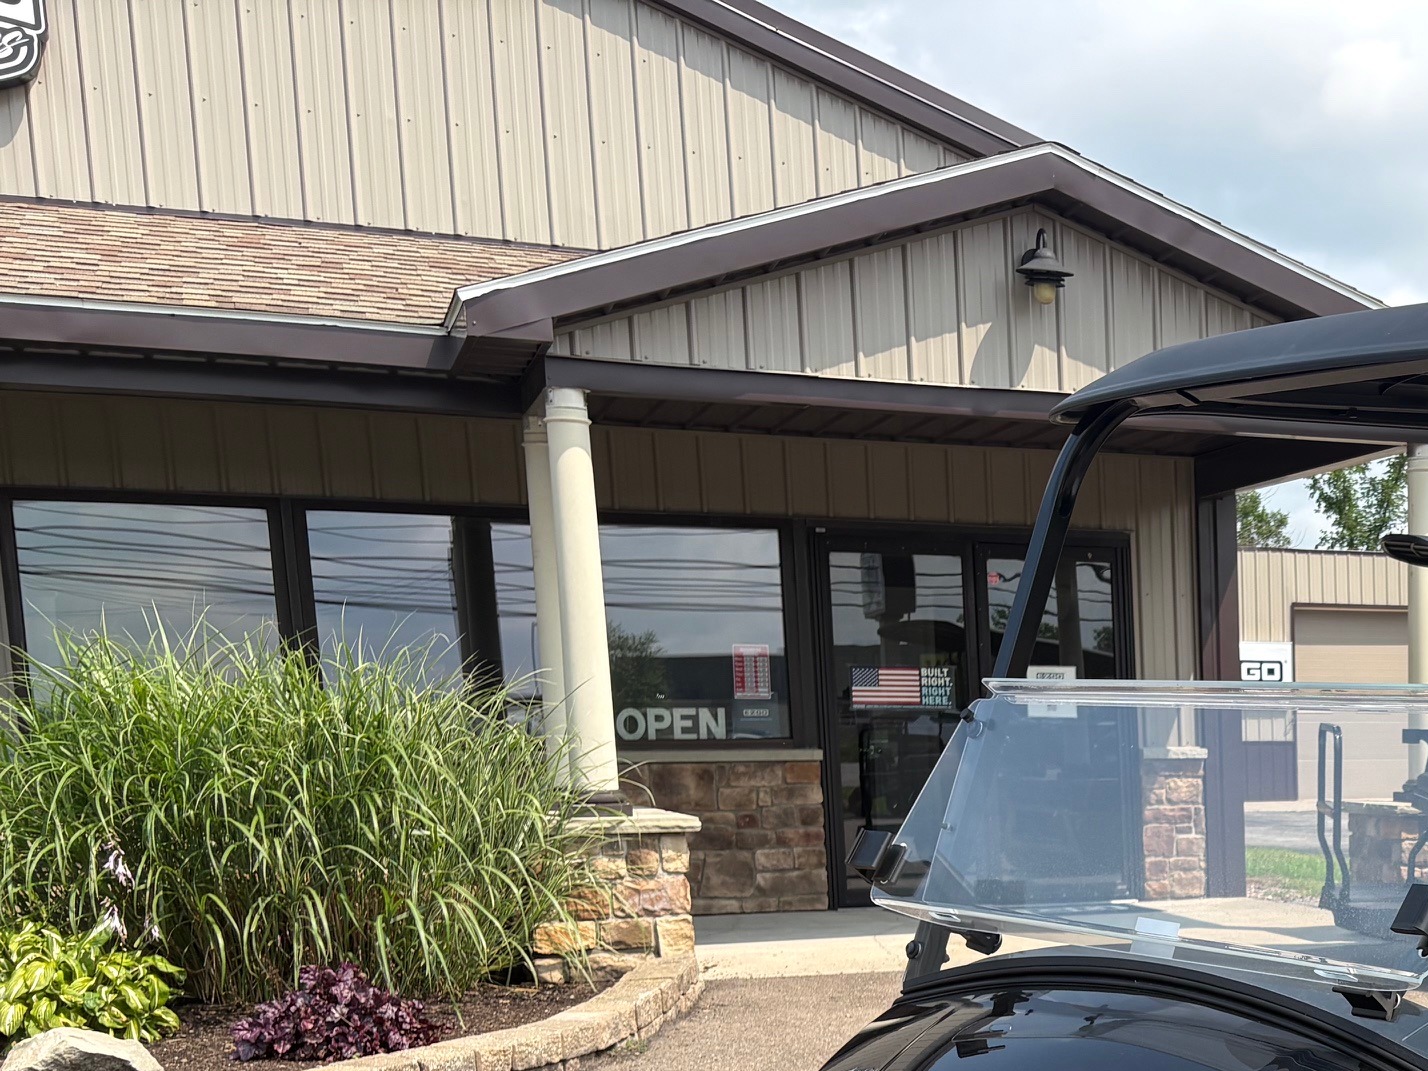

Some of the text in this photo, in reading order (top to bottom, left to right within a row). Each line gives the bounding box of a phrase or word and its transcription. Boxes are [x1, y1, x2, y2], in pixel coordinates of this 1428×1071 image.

[920, 667, 949, 677] BUILT
[921, 677, 953, 687] RIGHT.
[922, 687, 951, 696] RIGHT
[922, 696, 952, 705] HERE.
[616, 707, 727, 740] OPEN
